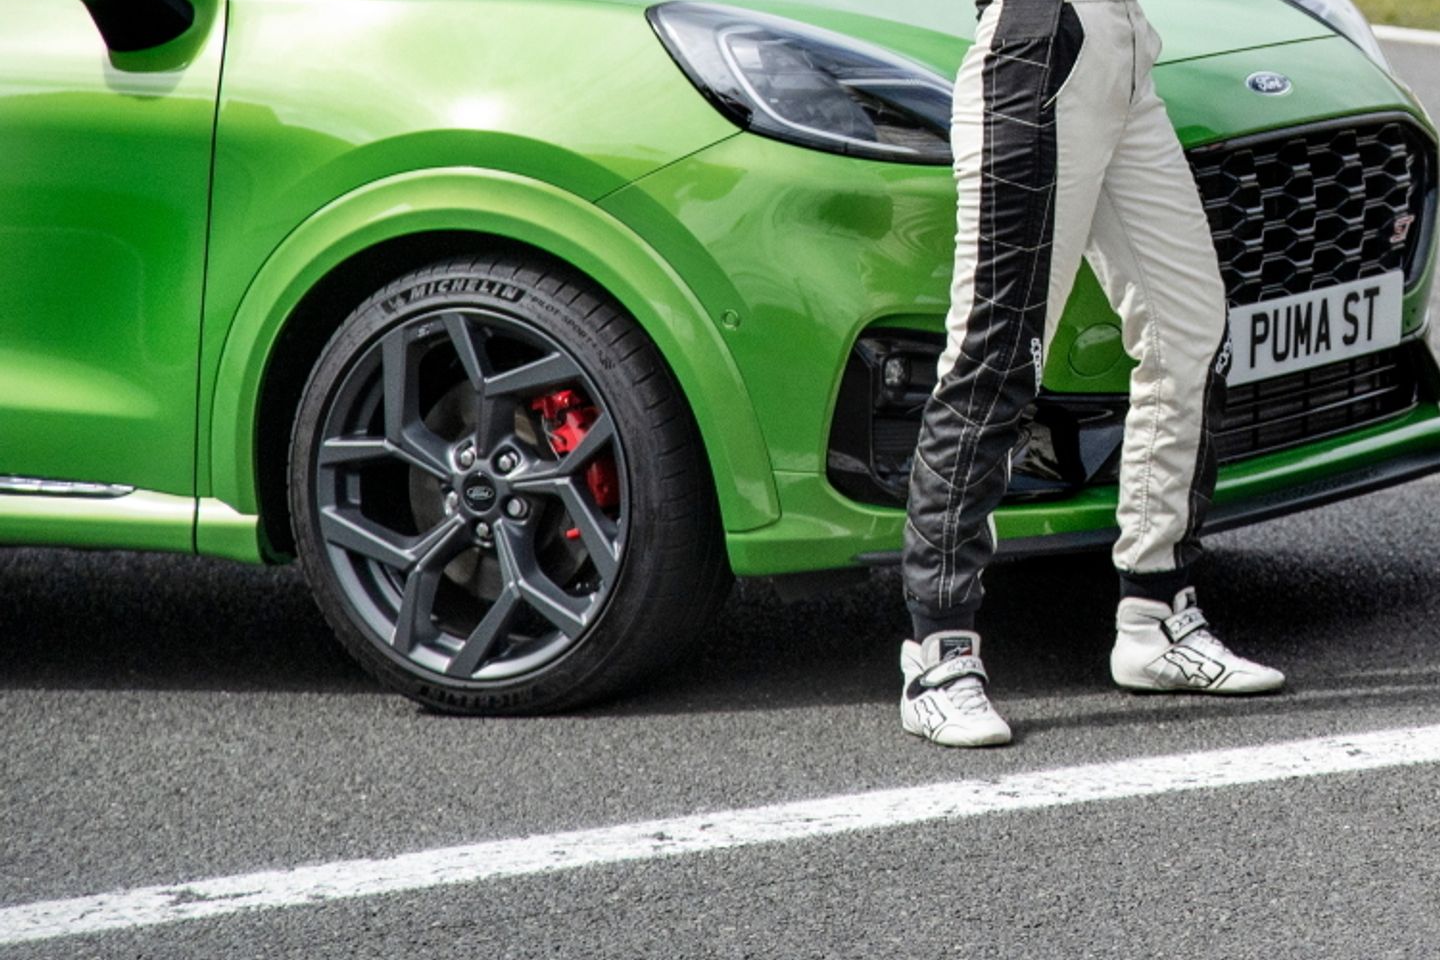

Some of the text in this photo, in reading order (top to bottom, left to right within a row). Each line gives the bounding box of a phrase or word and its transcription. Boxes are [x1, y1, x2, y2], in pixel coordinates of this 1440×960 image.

[410, 278, 519, 300] MICHELIN
[1249, 298, 1332, 369] PUMA
[1342, 286, 1381, 346] ST
